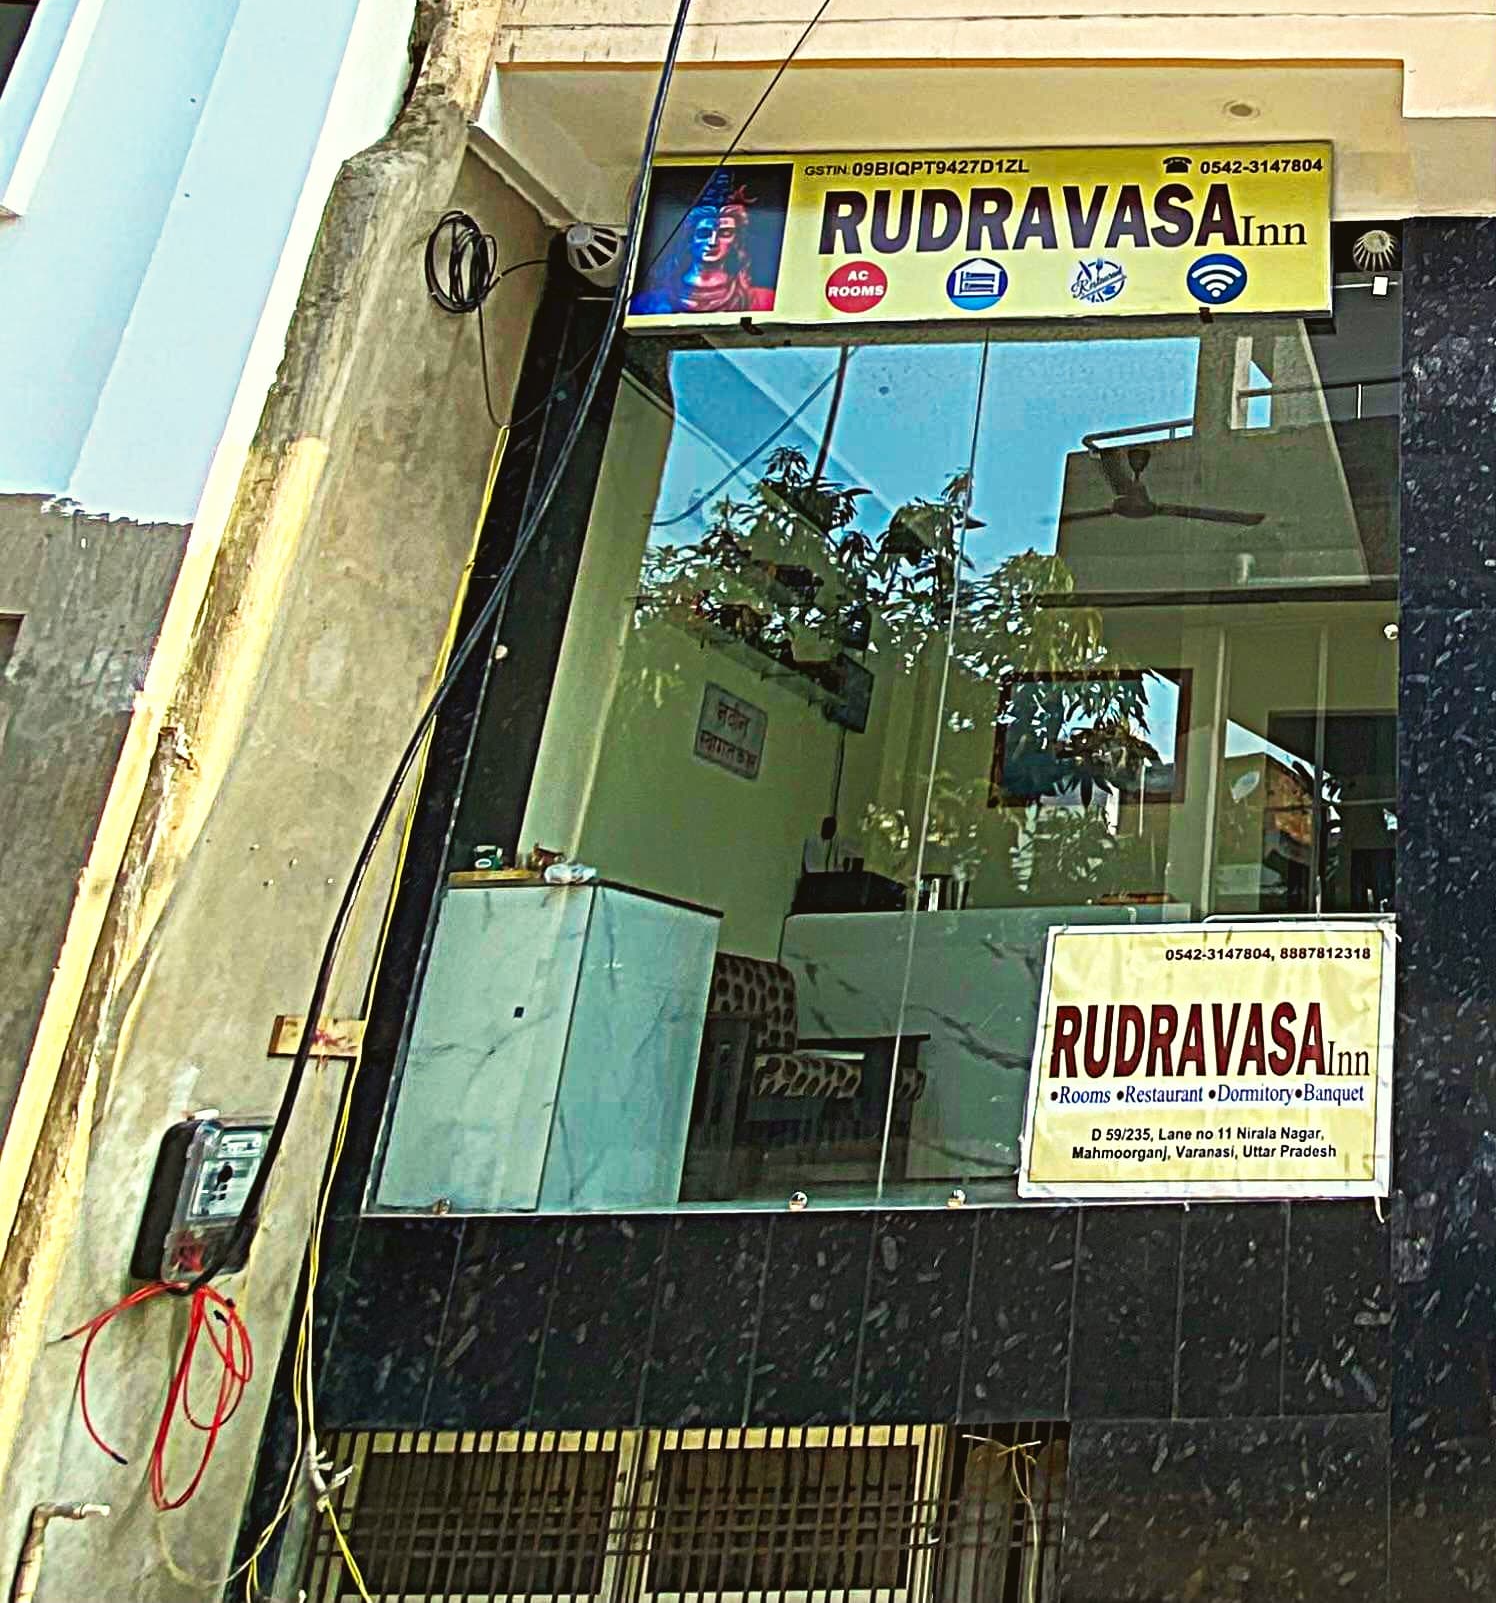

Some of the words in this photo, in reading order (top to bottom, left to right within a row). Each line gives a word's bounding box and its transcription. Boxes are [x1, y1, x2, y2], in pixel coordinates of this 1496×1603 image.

[1199, 158, 1323, 175] 0542-3147804
[818, 183, 1240, 255] RUDRAVASA
[1240, 215, 1307, 246] Inn
[847, 270, 869, 281] AC
[827, 285, 885, 297] ROOMS
[1165, 948, 1275, 961] 0542-3147804,
[1280, 947, 1371, 960] 8887812318
[1049, 1001, 1326, 1079] RUDRAVASA
[1327, 1040, 1370, 1077] Inn
[1091, 1128, 1102, 1141] D
[1106, 1128, 1154, 1142] 59/235,
[1159, 1128, 1192, 1141] Lane
[1196, 1130, 1214, 1140] no
[1218, 1127, 1232, 1140] 11
[1237, 1126, 1277, 1140] Nirala
[1280, 1126, 1325, 1142] Nagar,
[1072, 1146, 1172, 1162] Mahmoorganj,
[1176, 1145, 1239, 1160] Varanasi,
[1243, 1145, 1277, 1158] Uttar
[1280, 1144, 1337, 1158] Pradesh
